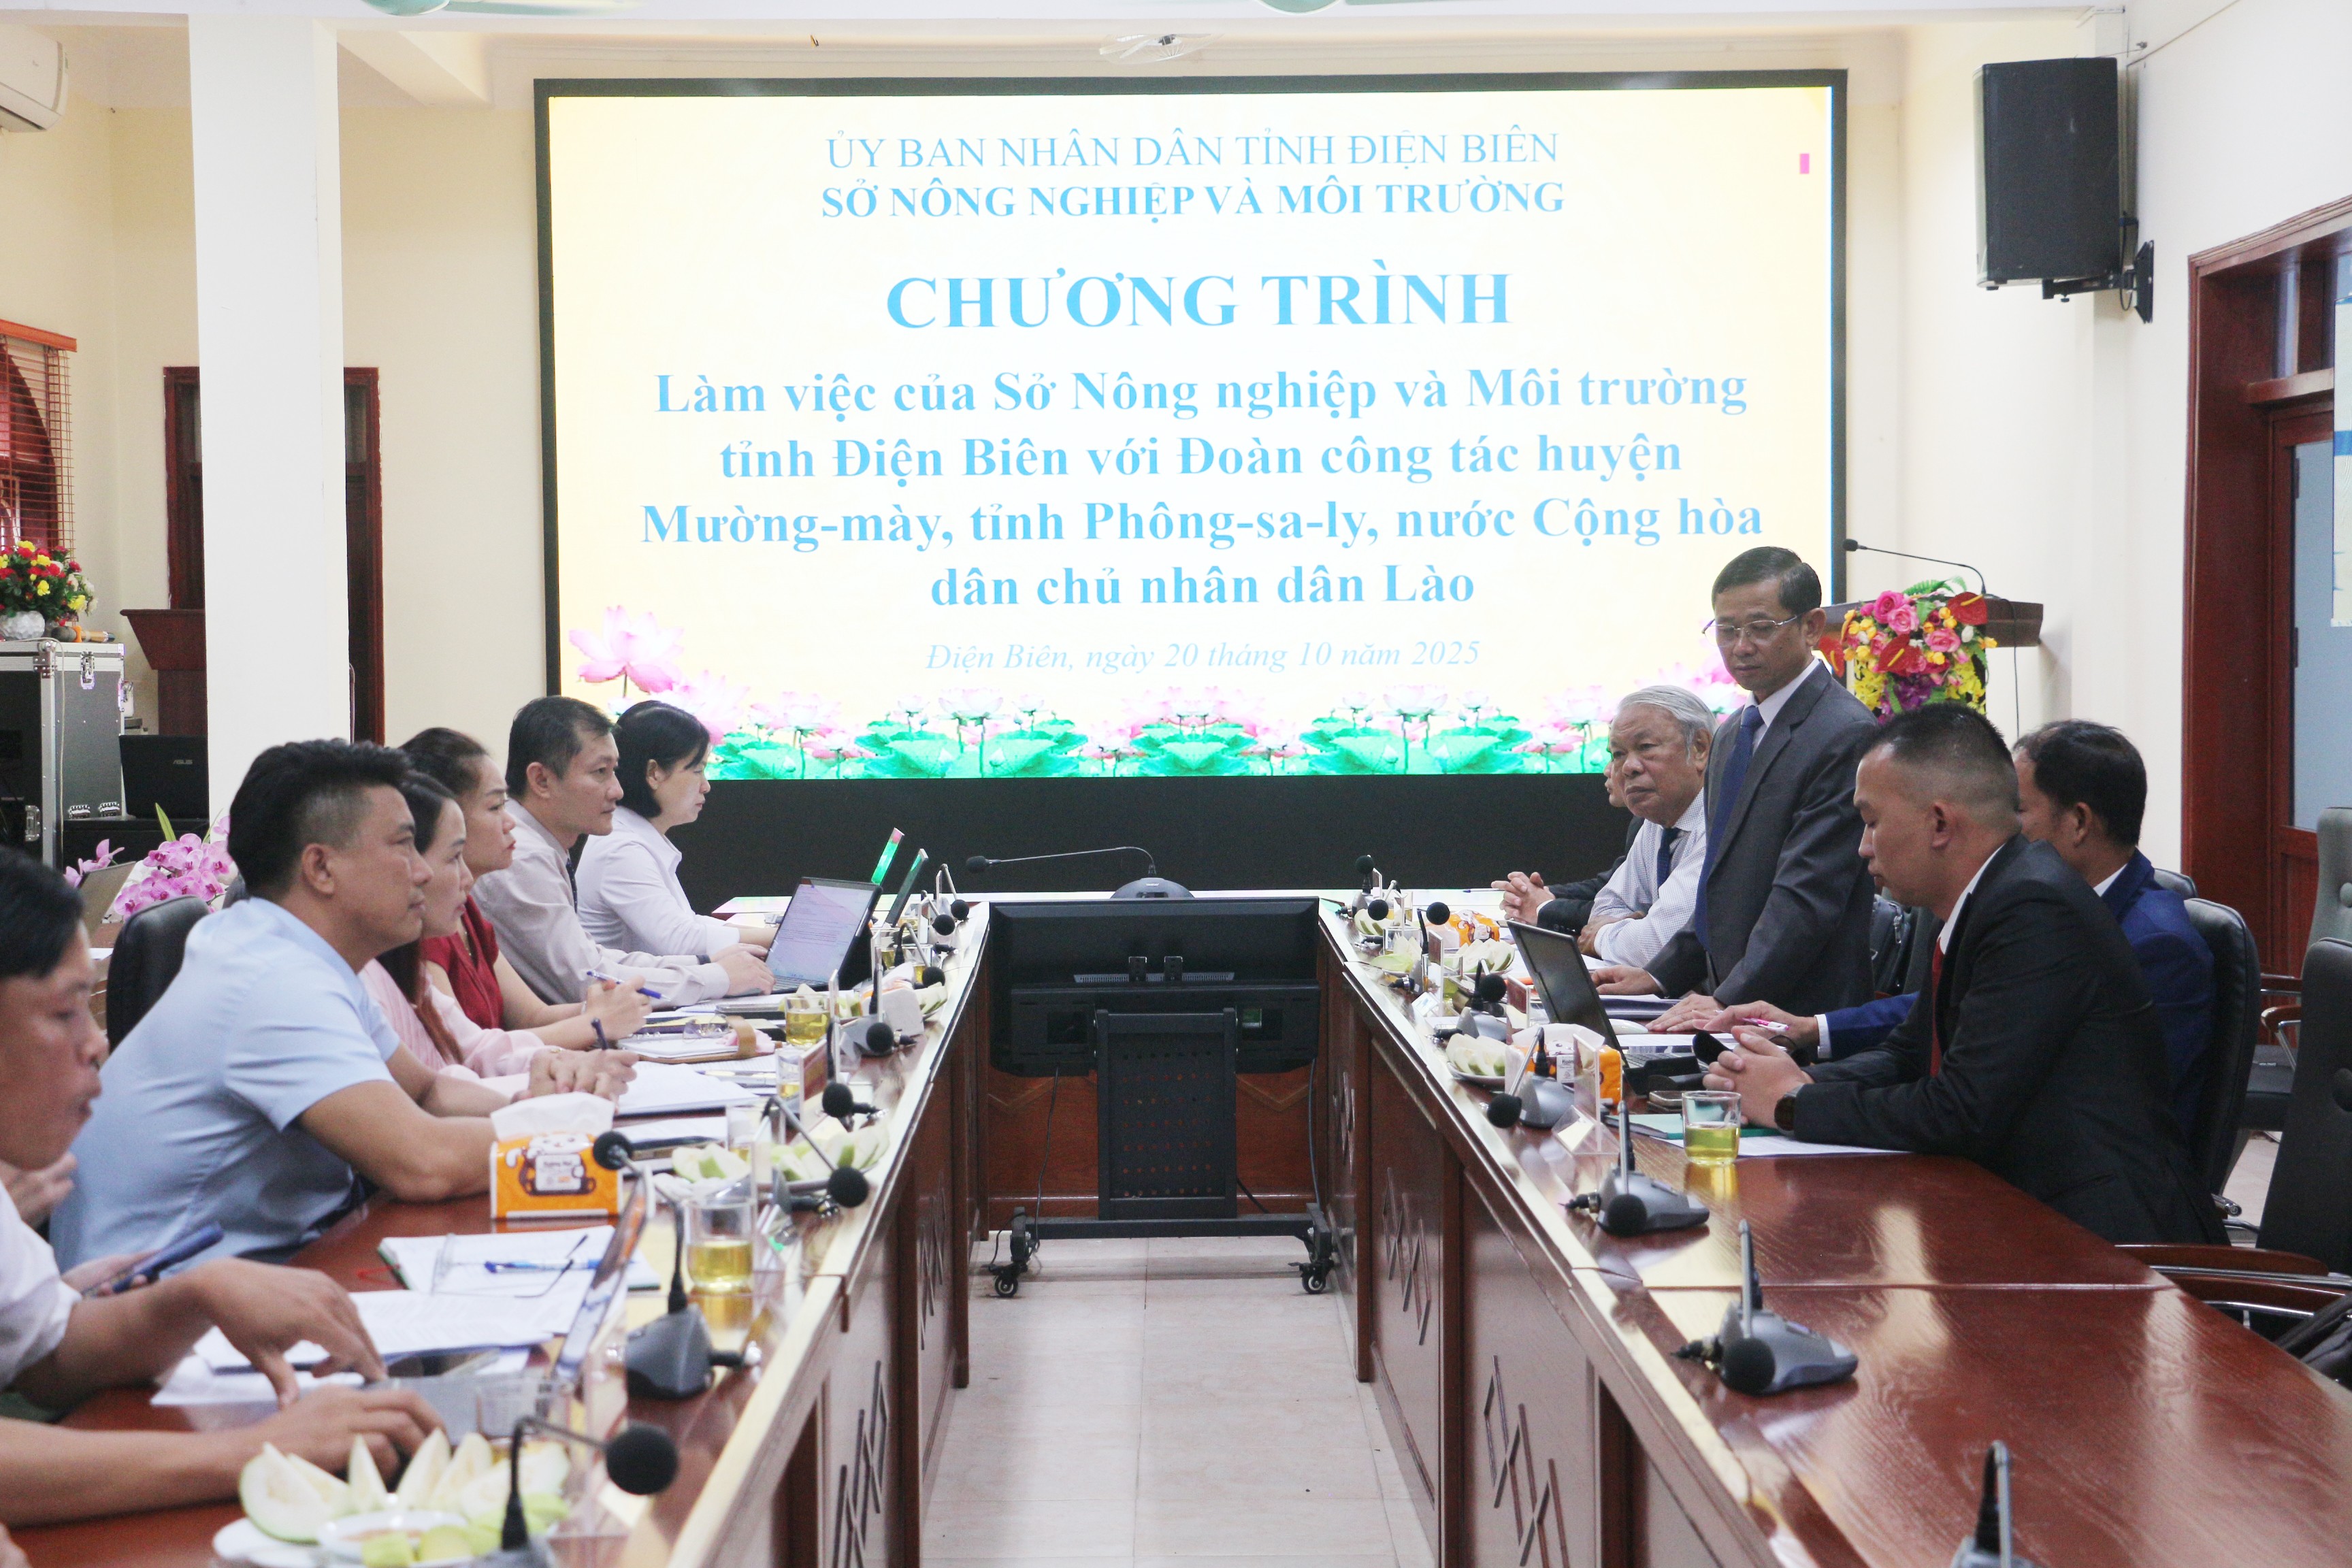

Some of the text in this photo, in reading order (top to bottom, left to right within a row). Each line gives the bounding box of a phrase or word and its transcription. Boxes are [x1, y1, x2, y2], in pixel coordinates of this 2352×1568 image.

[826, 124, 1558, 169] ỦY BAN NHÂN DÂN TỈNH ĐIỆN BIÊN
[822, 174, 1564, 225] SỞ NÔNG NGHIỆP VÀ MÔI TRƯỜNG
[884, 259, 1512, 329] CHƯƠNG TRÌNH
[656, 368, 1748, 423] Làm việc của Sở Nông nghiệp và Môi trường
[719, 433, 1681, 488] tỉnh Điện Biên với Đoàn công tác huyện
[642, 497, 1763, 553] Mường-mày, tỉnh Phông-sa-ly, nước Cộng hòa
[930, 564, 1475, 606] dân chủ nhân dân Lào
[926, 640, 1480, 674] Điện Biên, ngày 20 tháng 10 năm 2025
